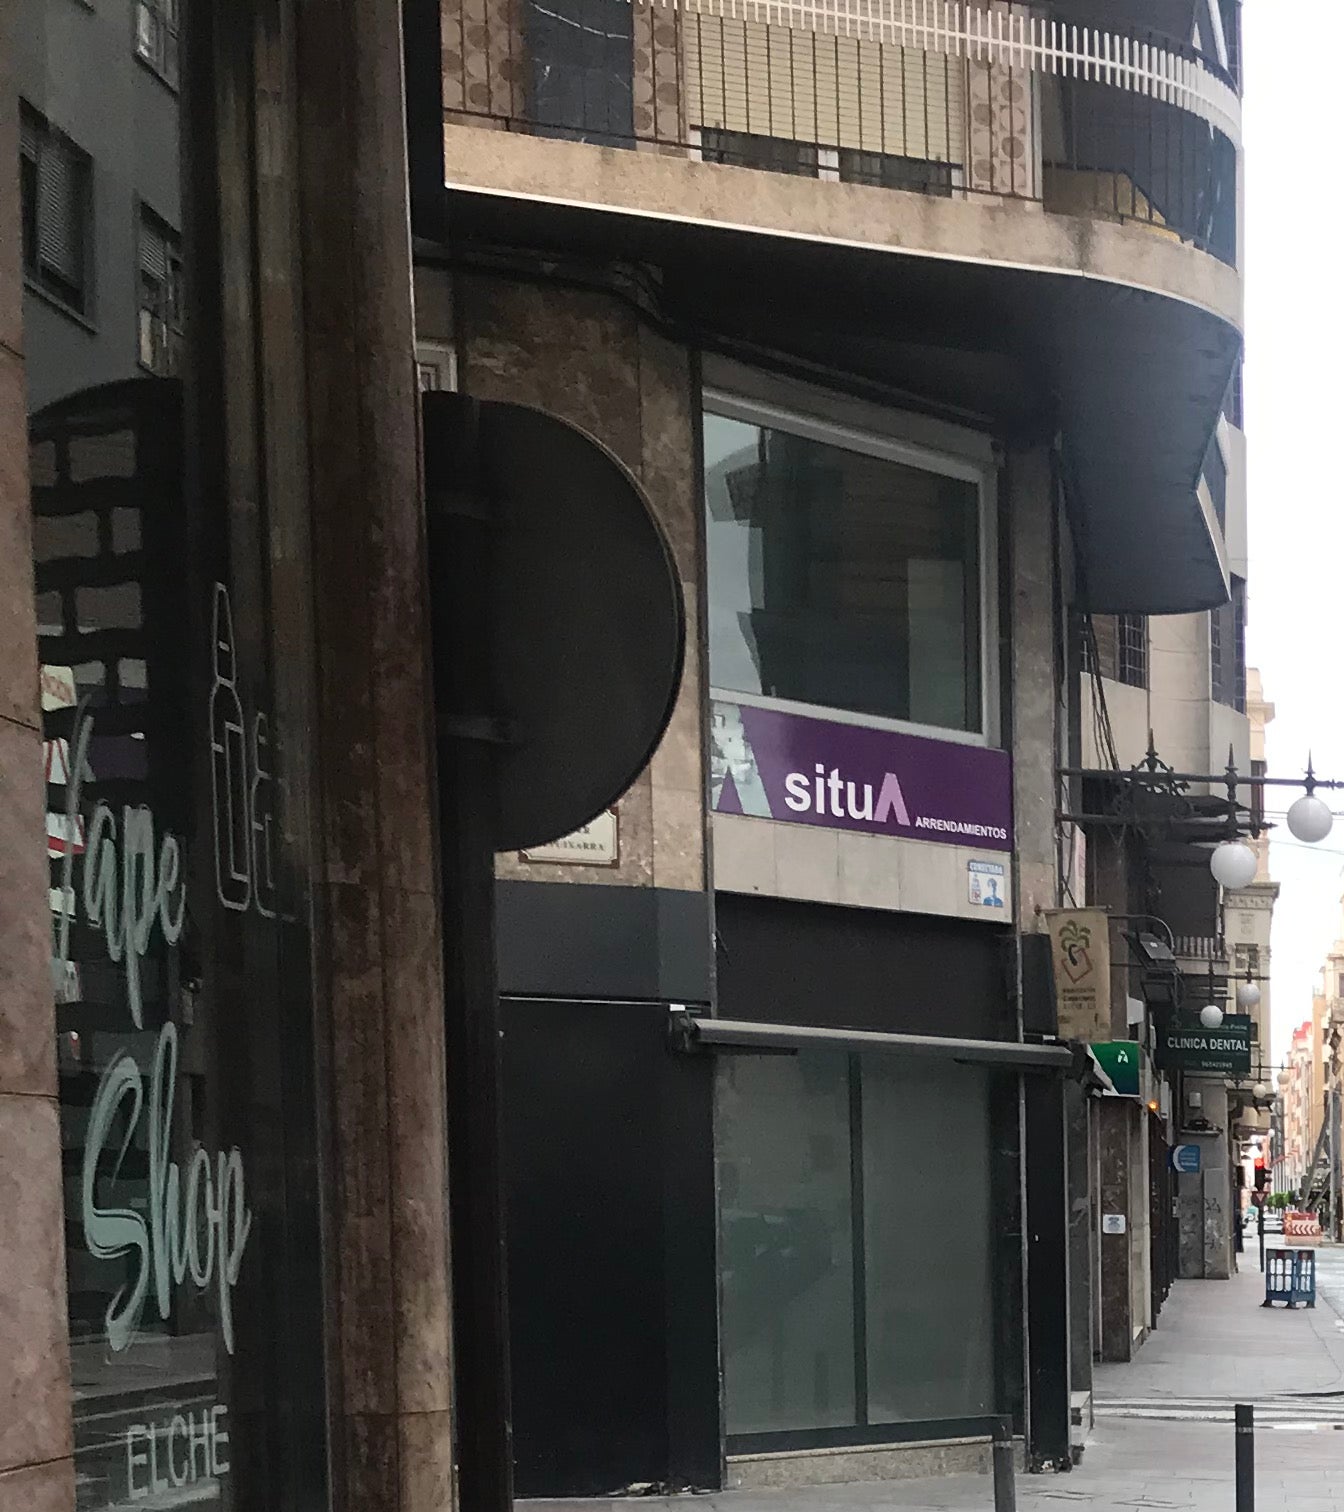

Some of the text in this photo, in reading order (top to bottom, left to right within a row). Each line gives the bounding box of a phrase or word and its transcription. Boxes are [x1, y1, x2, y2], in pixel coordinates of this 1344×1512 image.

[915, 816, 1008, 840] ARRENDAMIENTOS
[1167, 1037, 1249, 1051] CLINICA DENTAL
[82, 1021, 253, 1355] Shop
[127, 1404, 230, 1501] ELCHE
